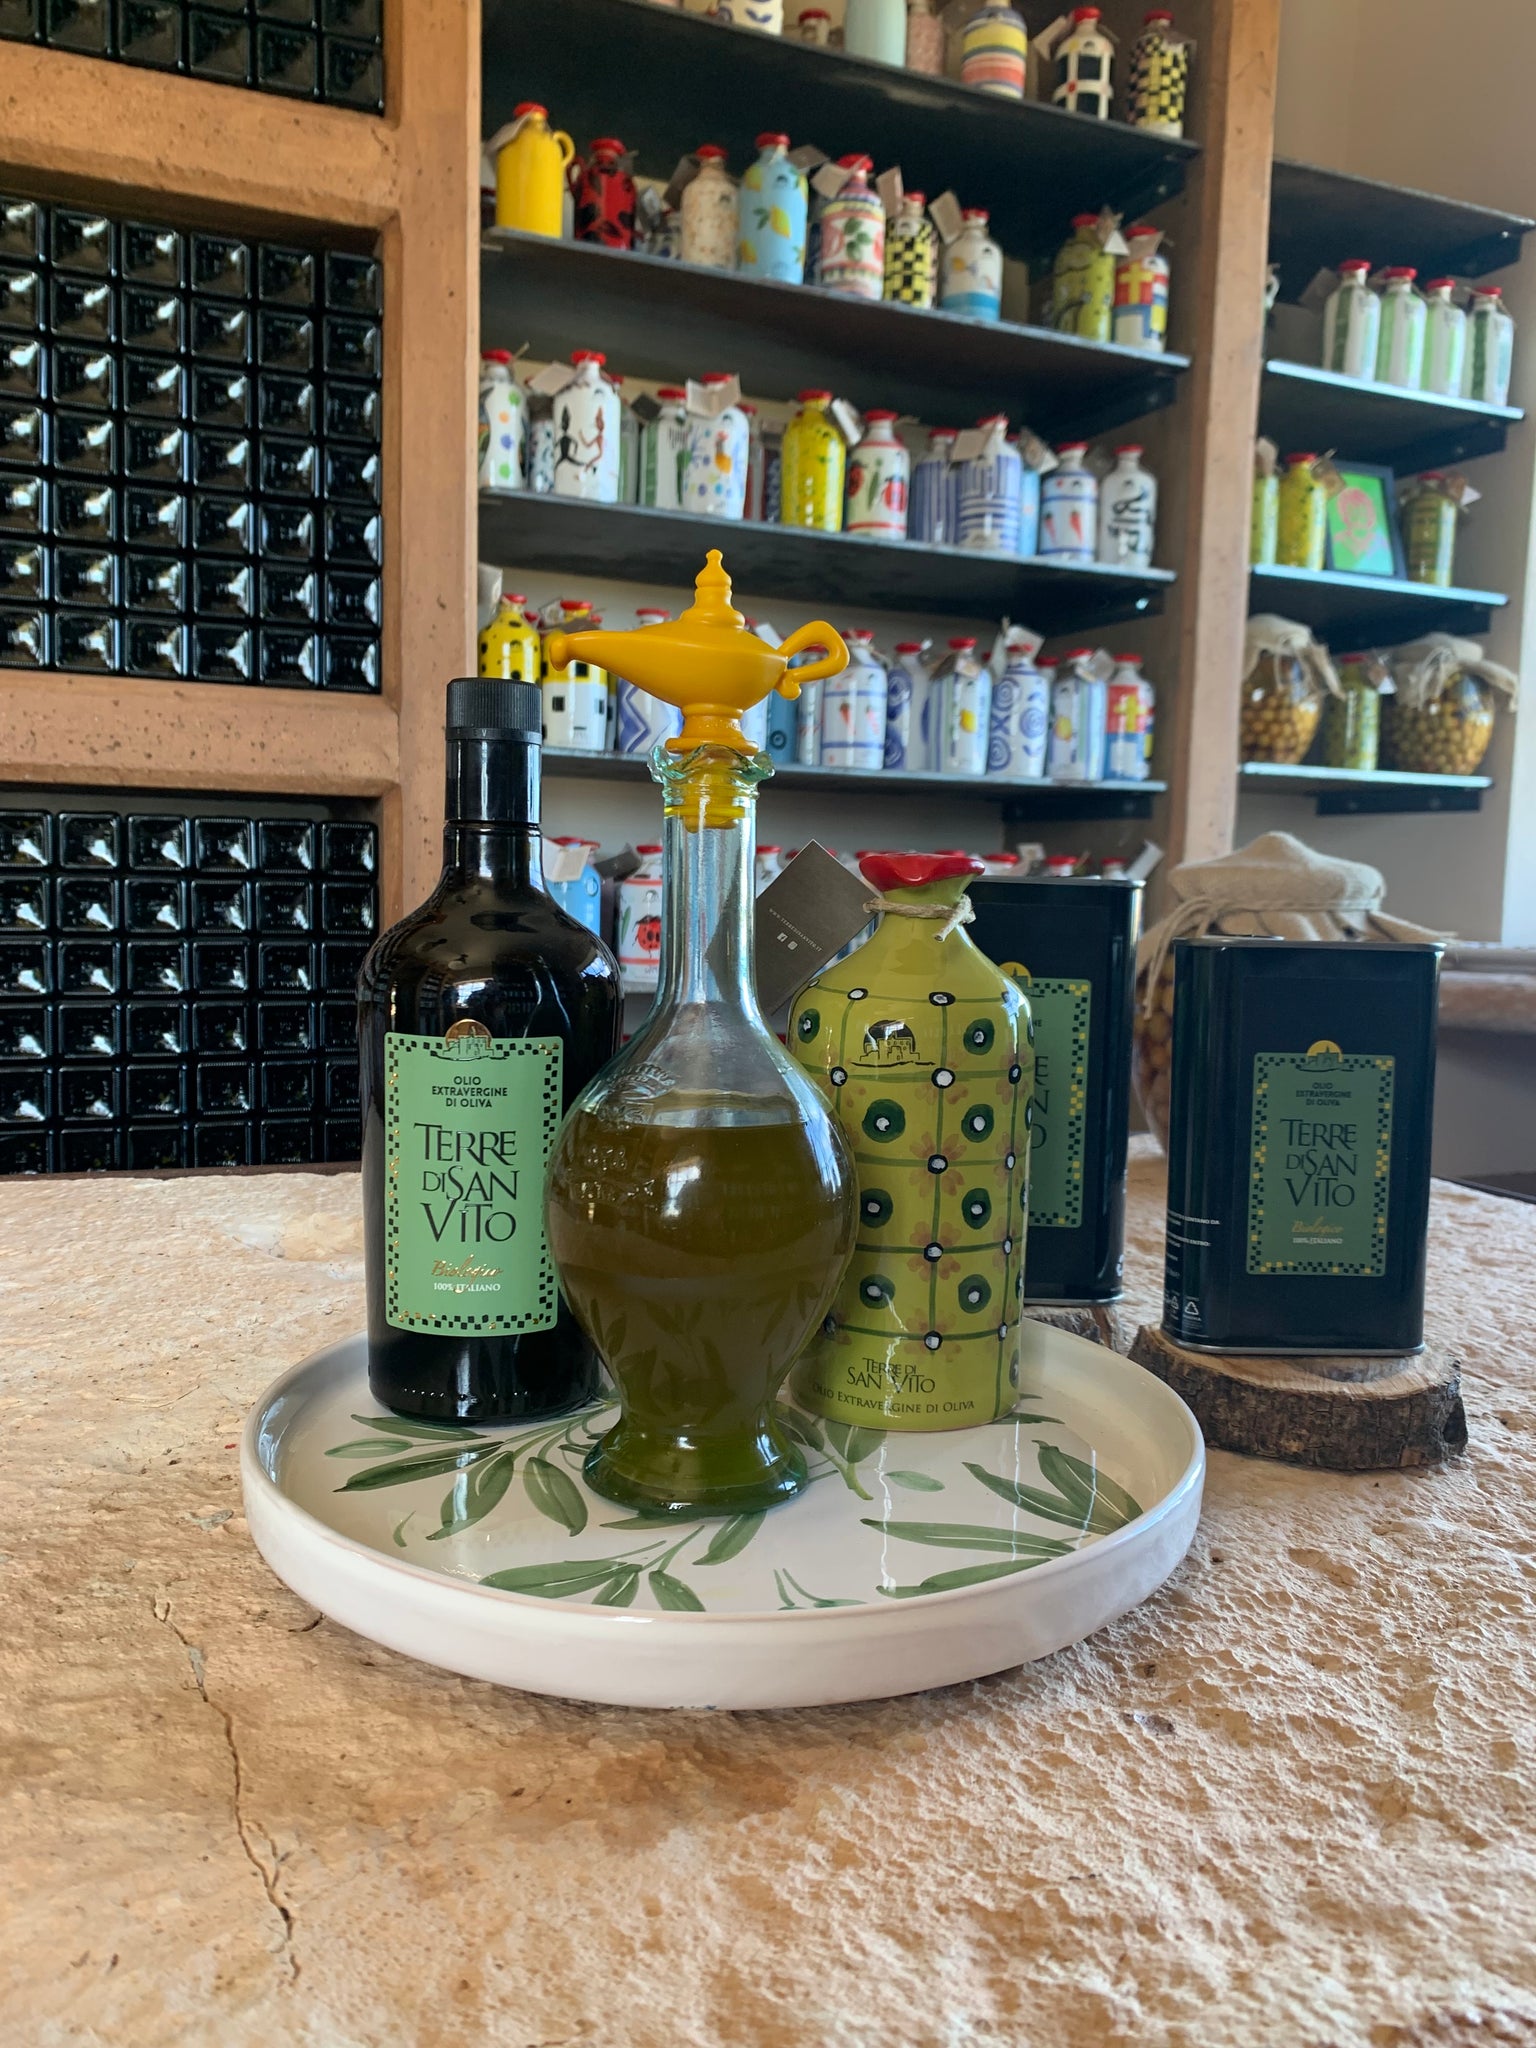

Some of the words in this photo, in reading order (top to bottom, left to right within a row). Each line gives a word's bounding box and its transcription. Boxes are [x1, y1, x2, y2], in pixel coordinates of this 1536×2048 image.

[432, 1086, 508, 1097] EXTRAVERGINE
[453, 1076, 481, 1085] OLIO
[445, 1098, 457, 1107] DI
[460, 1098, 492, 1108] OLIVA
[414, 1122, 517, 1167] TERRE
[1280, 1118, 1357, 1151] TERRE
[1282, 1174, 1356, 1207] VITO
[420, 1199, 517, 1243] VITO
[433, 1282, 453, 1291] 100%
[456, 1283, 501, 1292] ITALIANO
[847, 1366, 883, 1390] SAN
[889, 1374, 936, 1394] VITO
[862, 1357, 902, 1377] TERRE
[905, 1364, 918, 1375] DI
[812, 1382, 835, 1399] OLIO
[926, 1403, 939, 1413] DI
[943, 1401, 975, 1412] OLIVA
